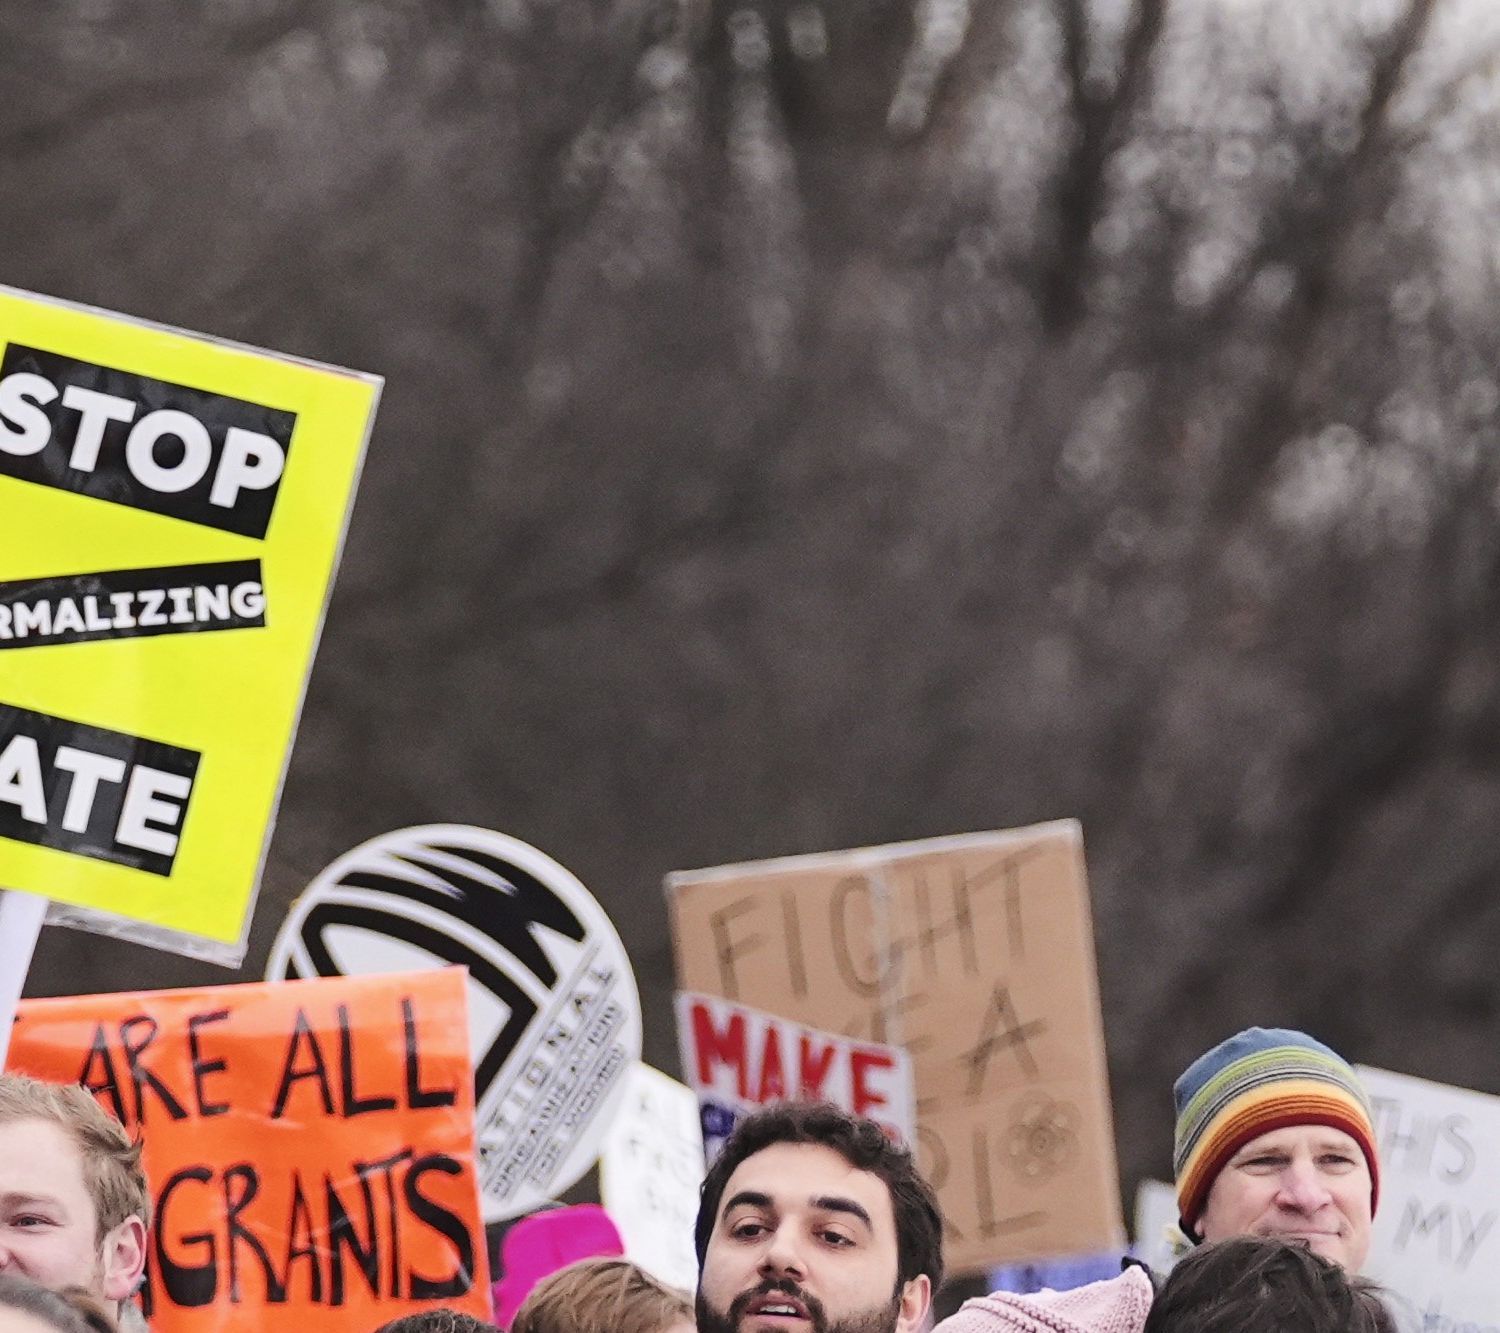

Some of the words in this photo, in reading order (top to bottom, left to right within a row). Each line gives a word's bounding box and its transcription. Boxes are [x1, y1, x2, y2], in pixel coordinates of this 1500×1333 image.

[710, 846, 1042, 1000] FIGHT
[79, 1010, 229, 1127] ARE
[272, 998, 458, 1118] ALL
[477, 966, 618, 1166] ATIONAL
[691, 1002, 902, 1143] MAKE
[959, 978, 1047, 1095] A
[1370, 1097, 1477, 1185] THIS
[138, 1148, 475, 1316] GRANTS
[1393, 1196, 1499, 1272] MY
